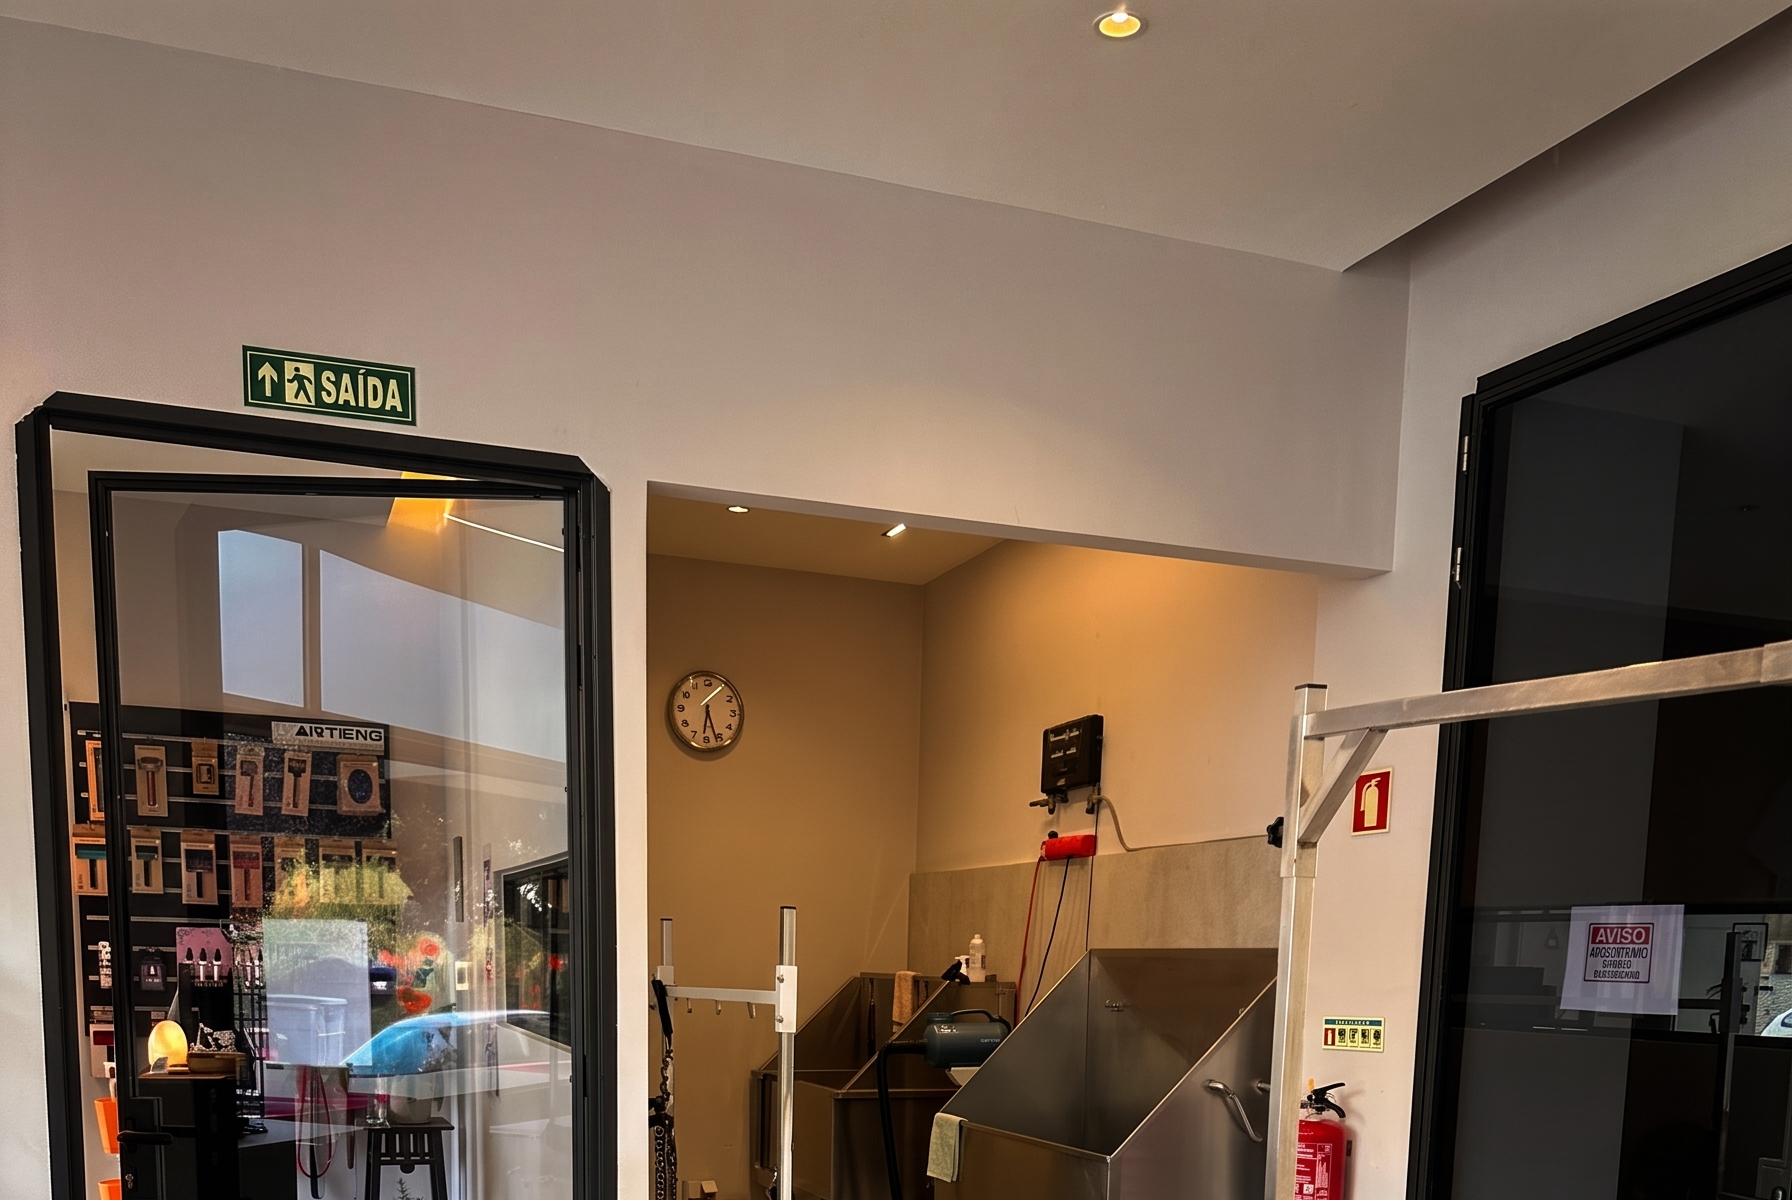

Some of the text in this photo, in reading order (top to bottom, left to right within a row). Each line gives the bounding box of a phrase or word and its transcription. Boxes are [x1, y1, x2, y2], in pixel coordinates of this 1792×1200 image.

[321, 369, 403, 412] SAÍDA
[726, 695, 733, 703] 2
[677, 704, 685, 712] 9
[729, 709, 737, 718] 3
[681, 719, 689, 728] 8
[691, 730, 697, 738] 7
[1595, 928, 1646, 943] AVISO
